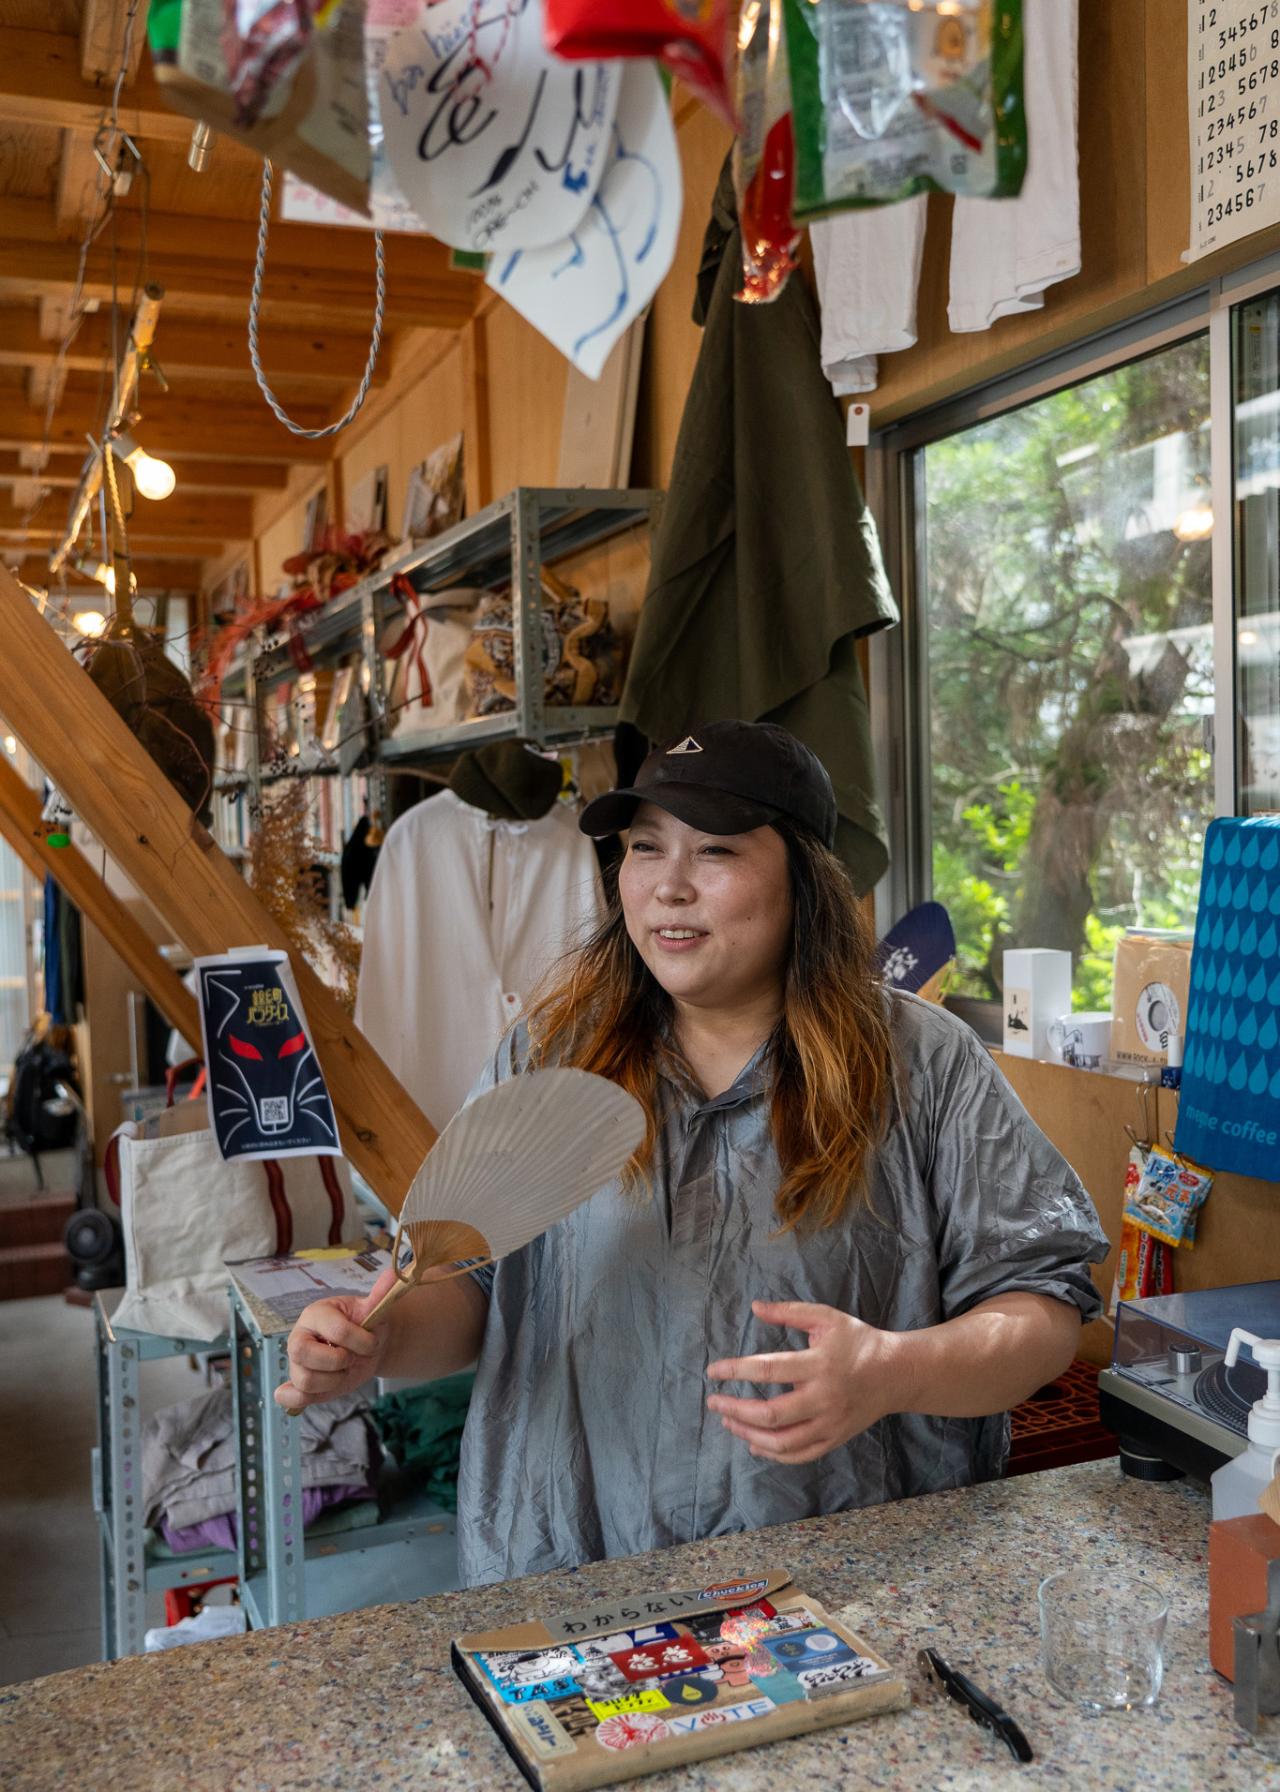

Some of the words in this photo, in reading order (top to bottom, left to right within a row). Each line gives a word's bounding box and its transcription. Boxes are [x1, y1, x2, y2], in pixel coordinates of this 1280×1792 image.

[1221, 1120, 1278, 1145] coffee
[563, 1595, 694, 1634] わからない
